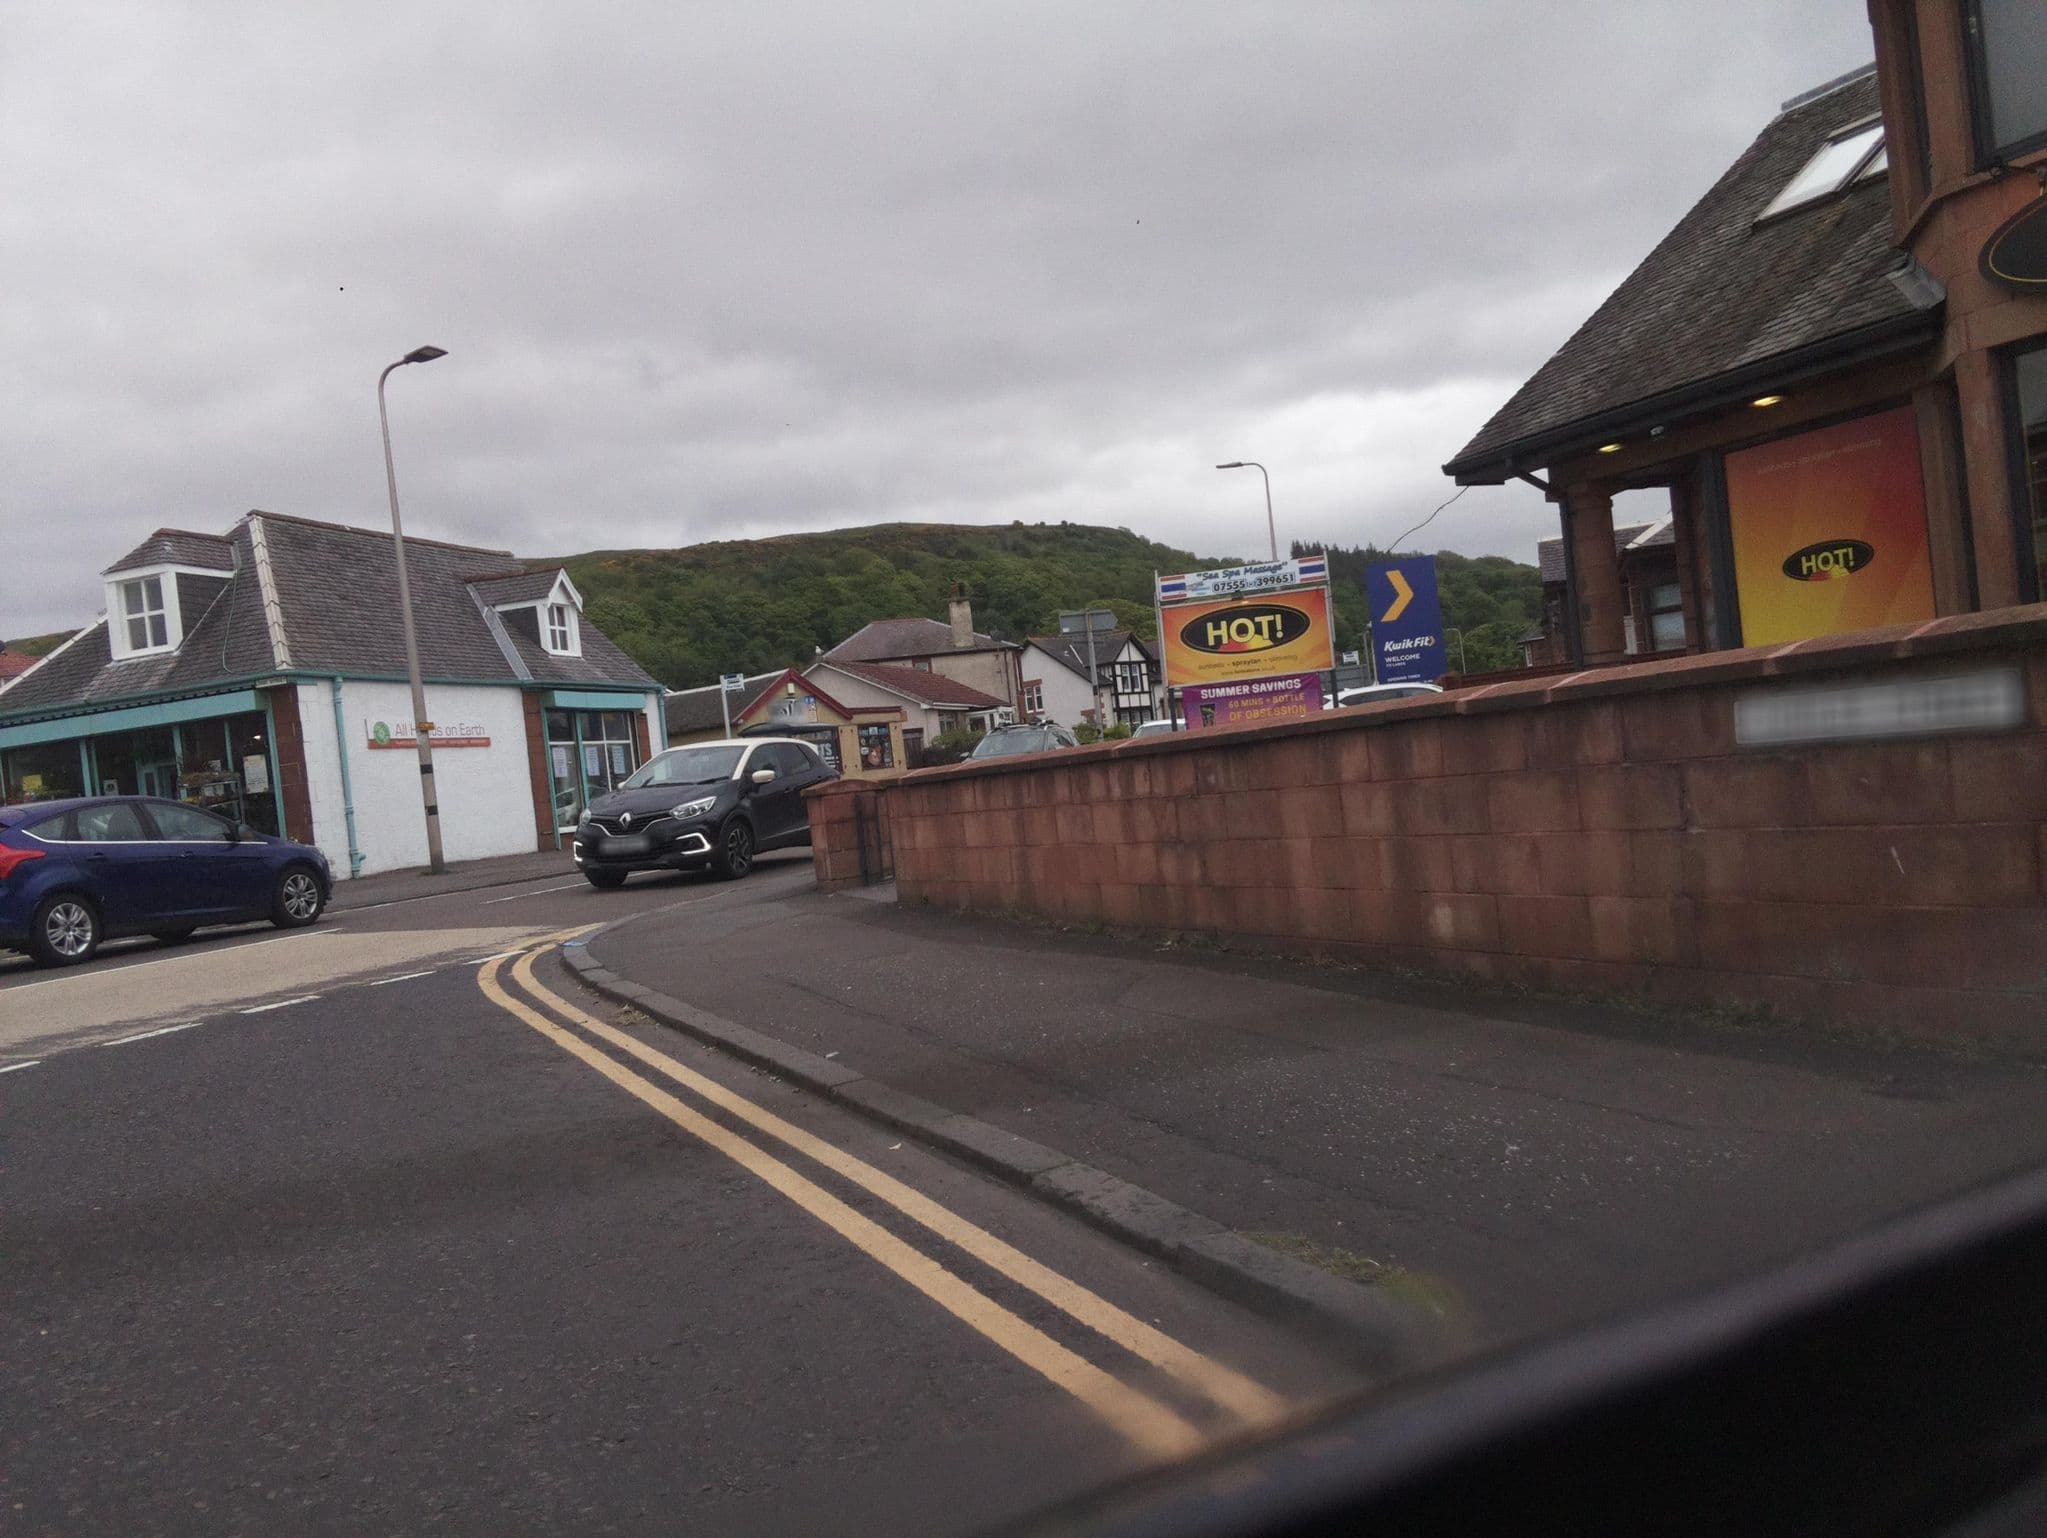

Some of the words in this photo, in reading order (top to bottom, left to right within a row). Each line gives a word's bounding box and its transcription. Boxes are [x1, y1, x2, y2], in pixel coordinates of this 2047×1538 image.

[1801, 547, 1855, 575] HOT!
[1222, 569, 1240, 579] Spa
[1213, 580, 1245, 592] 07555
[1256, 574, 1294, 587] 399651
[1206, 614, 1284, 646] HOT!
[1384, 653, 1421, 663] WELCOME
[1200, 684, 1250, 699] SUMMER
[1252, 678, 1302, 694] SAVINGS
[1272, 692, 1305, 704] BOTTLE
[1230, 711, 1242, 721] OF
[1245, 704, 1307, 720] OBSESSION
[395, 721, 408, 736] All
[446, 726, 457, 736] on
[460, 722, 486, 736] Earth
